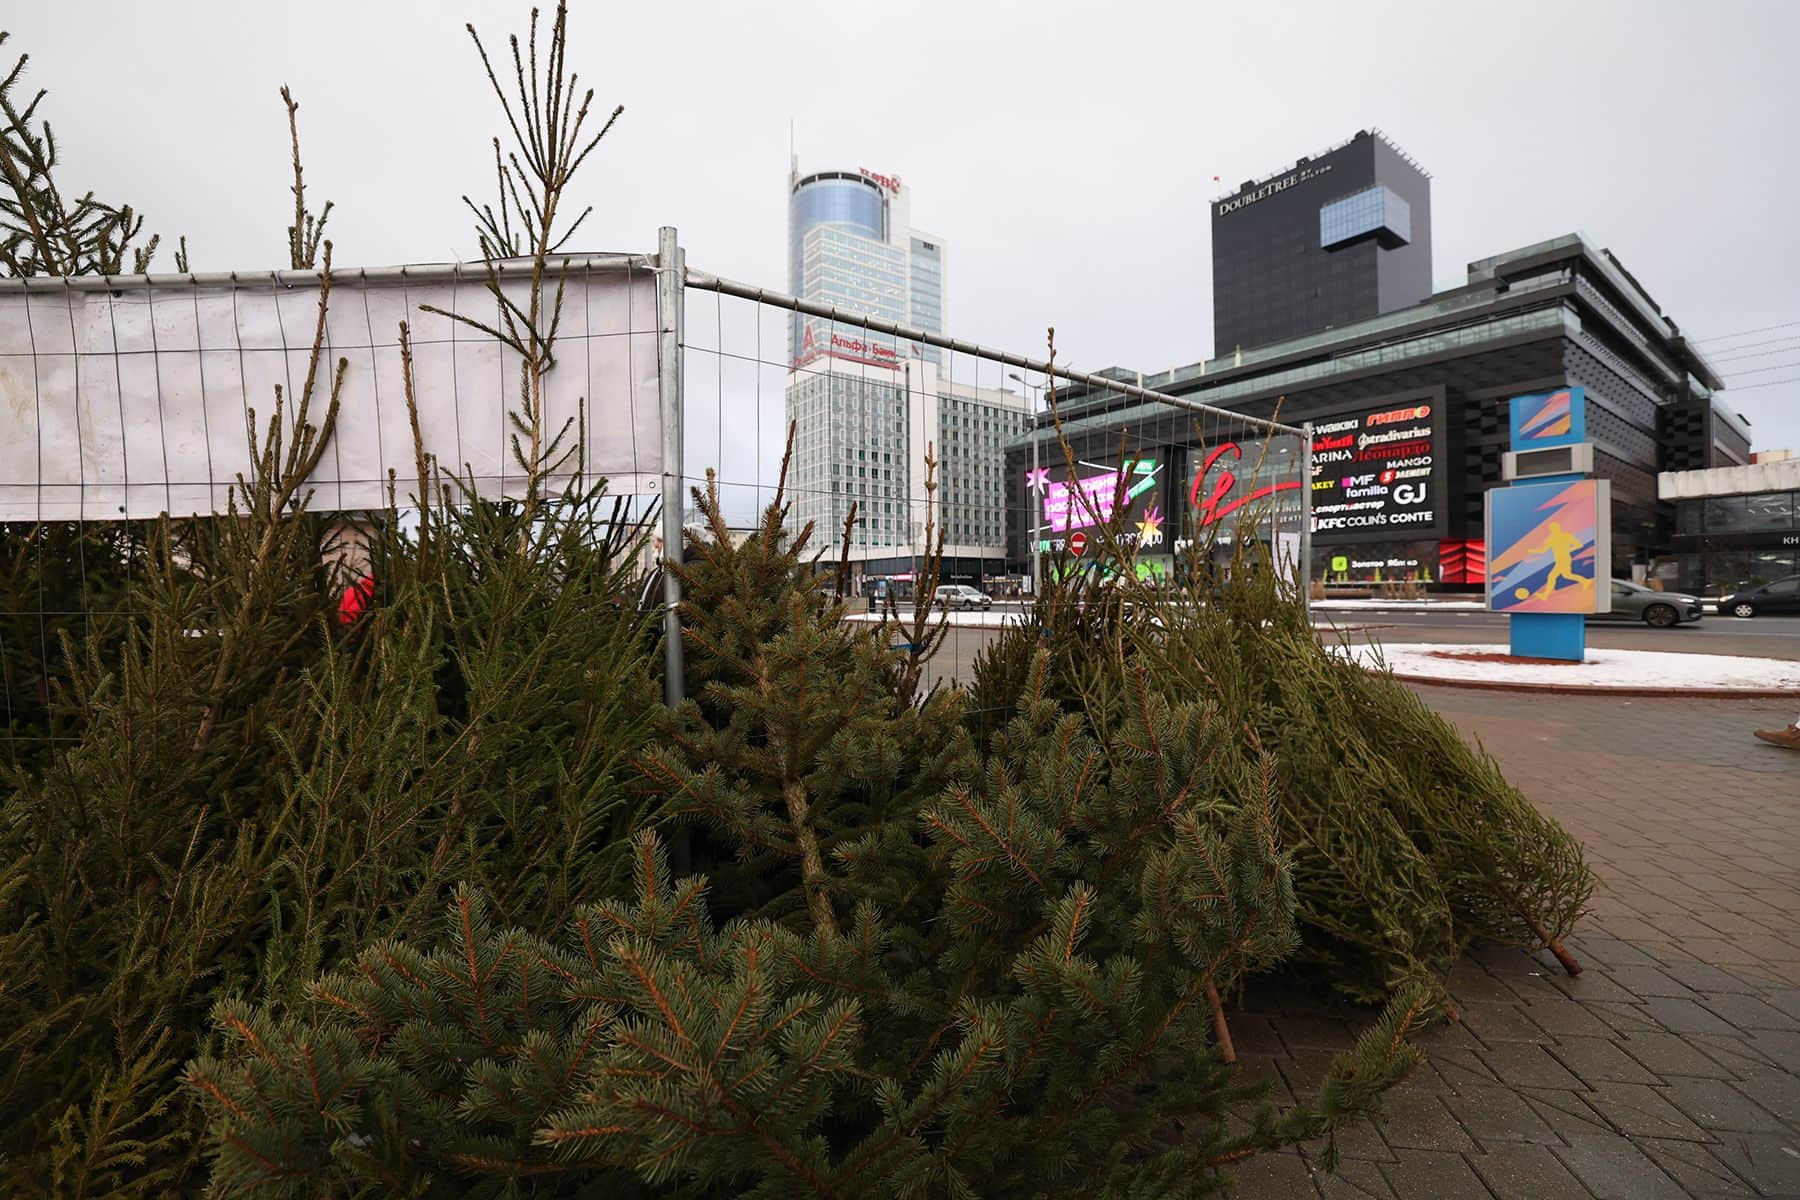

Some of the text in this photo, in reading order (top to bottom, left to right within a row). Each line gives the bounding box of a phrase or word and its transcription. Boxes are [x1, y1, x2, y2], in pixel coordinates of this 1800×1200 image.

[1386, 456, 1432, 470] MANGO
[1350, 474, 1376, 487] MF
[1346, 485, 1389, 498] familia
[1393, 482, 1426, 505] GJ
[1317, 517, 1347, 530] KFC
[1389, 511, 1433, 524] CONTE
